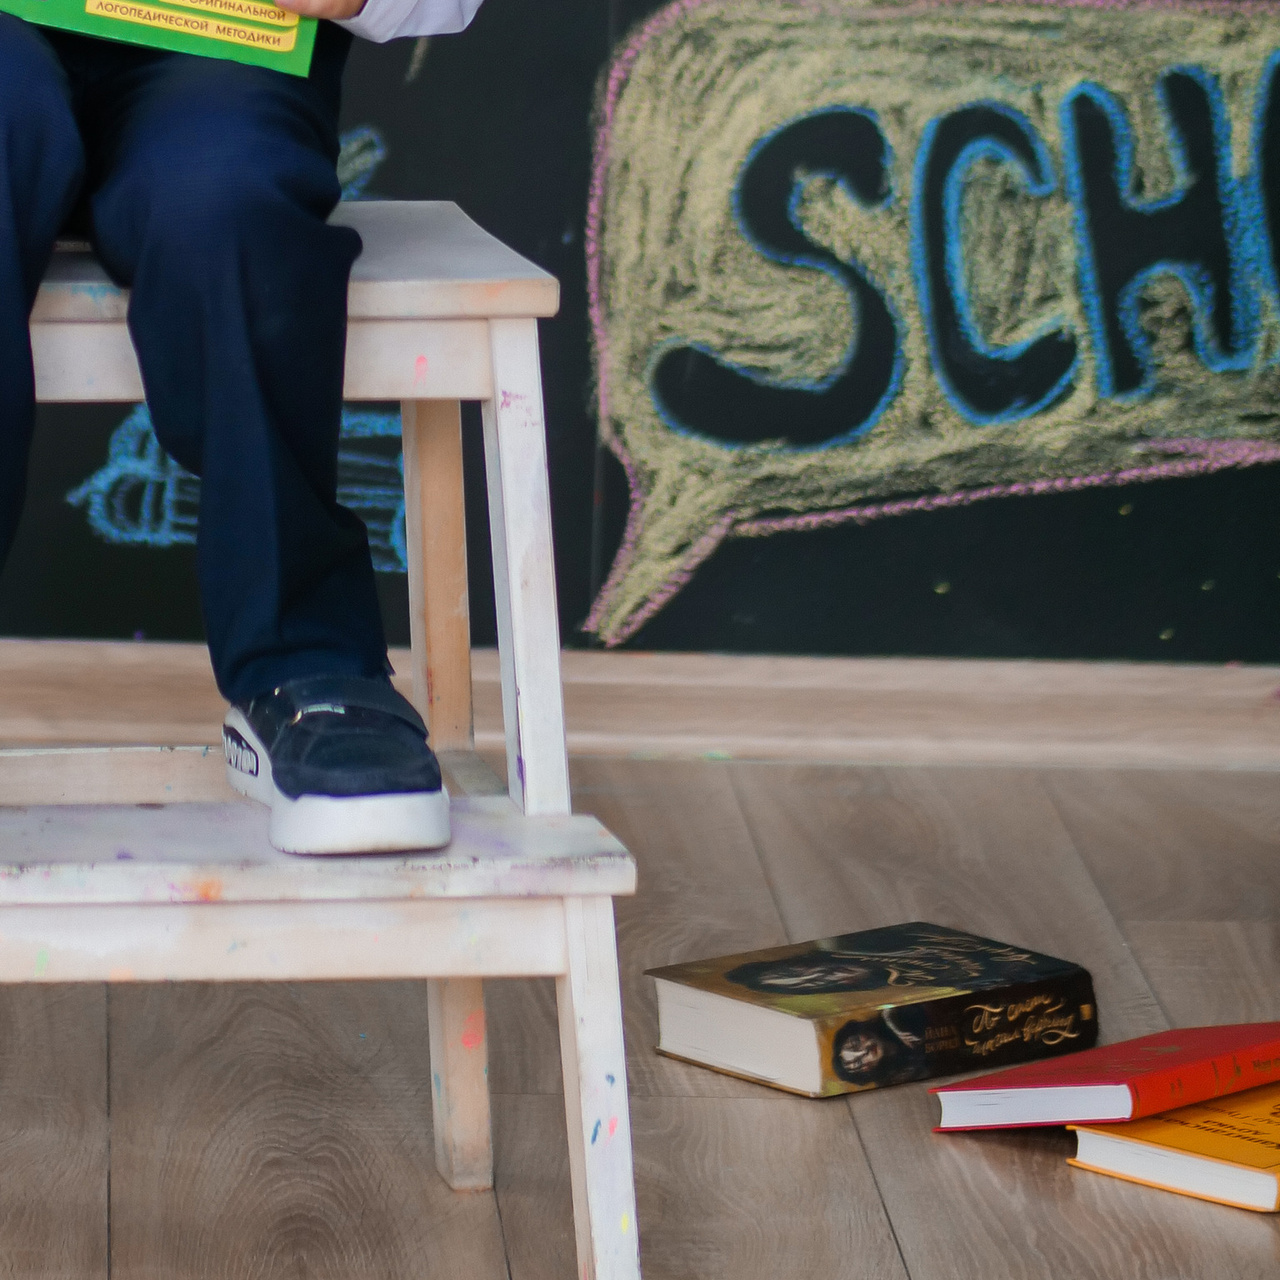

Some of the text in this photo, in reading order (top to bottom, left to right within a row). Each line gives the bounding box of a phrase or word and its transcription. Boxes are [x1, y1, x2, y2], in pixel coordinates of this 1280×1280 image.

[96, 1, 281, 47] ЛОГОПЕДИЧЕСКОЙ МЕТОДИКИ
[649, 48, 1280, 453] SCH
